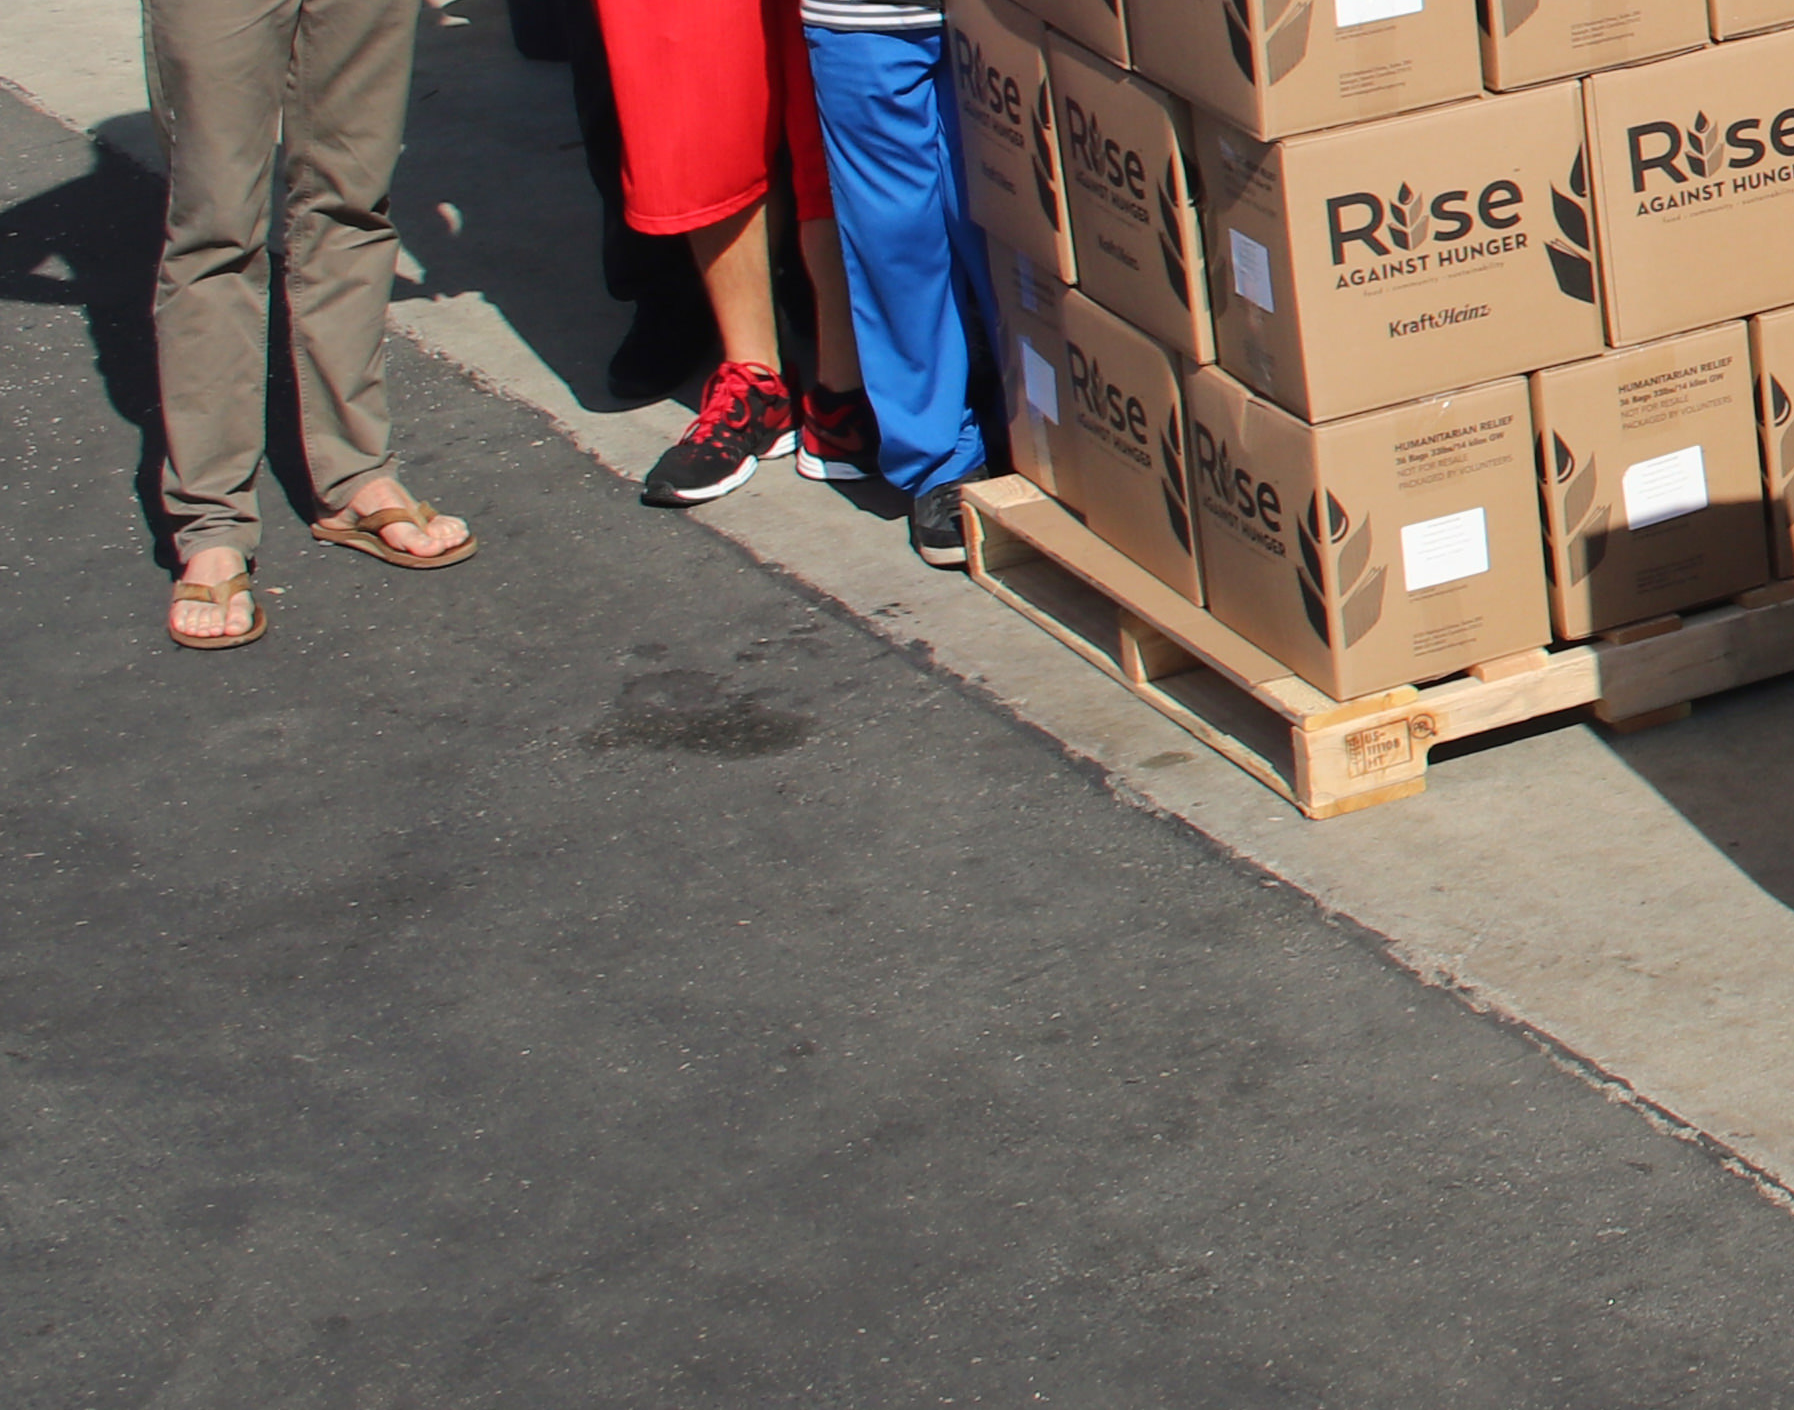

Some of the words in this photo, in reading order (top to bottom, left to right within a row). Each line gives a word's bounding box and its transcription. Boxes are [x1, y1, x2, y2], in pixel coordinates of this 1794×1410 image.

[1326, 179, 1526, 266] Rise
[1636, 181, 1724, 217] AGAINST
[1335, 252, 1431, 290] AGAINST
[1438, 231, 1528, 270] HUNGER
